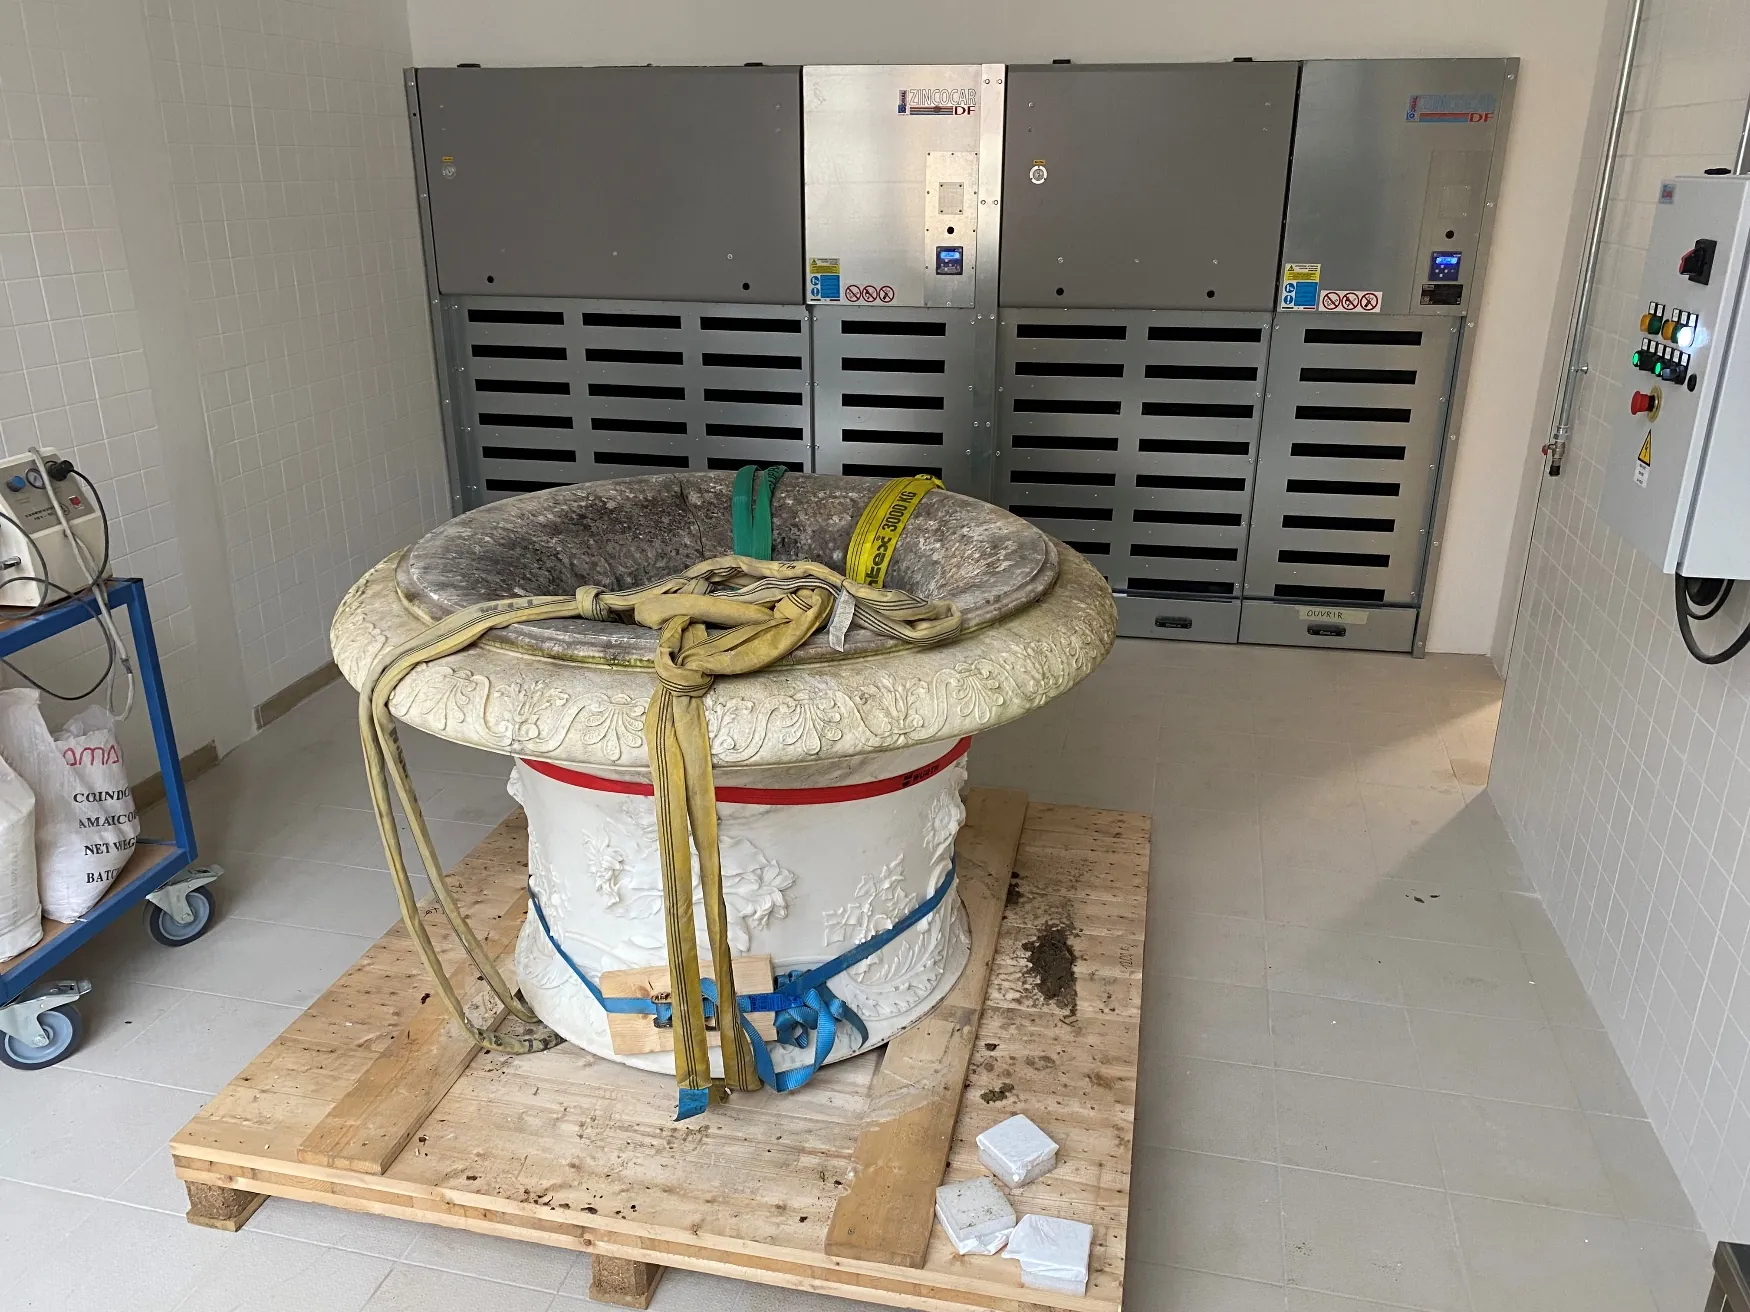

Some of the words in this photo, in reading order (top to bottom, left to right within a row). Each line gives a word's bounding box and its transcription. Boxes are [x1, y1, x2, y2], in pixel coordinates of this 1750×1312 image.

[909, 88, 977, 106] ZINCOCAR
[954, 105, 976, 116] DF
[1468, 111, 1495, 123] DF
[882, 503, 908, 533] 3000
[898, 490, 919, 504] KG
[1306, 609, 1343, 620] OUVRIR
[84, 842, 110, 856] NET
